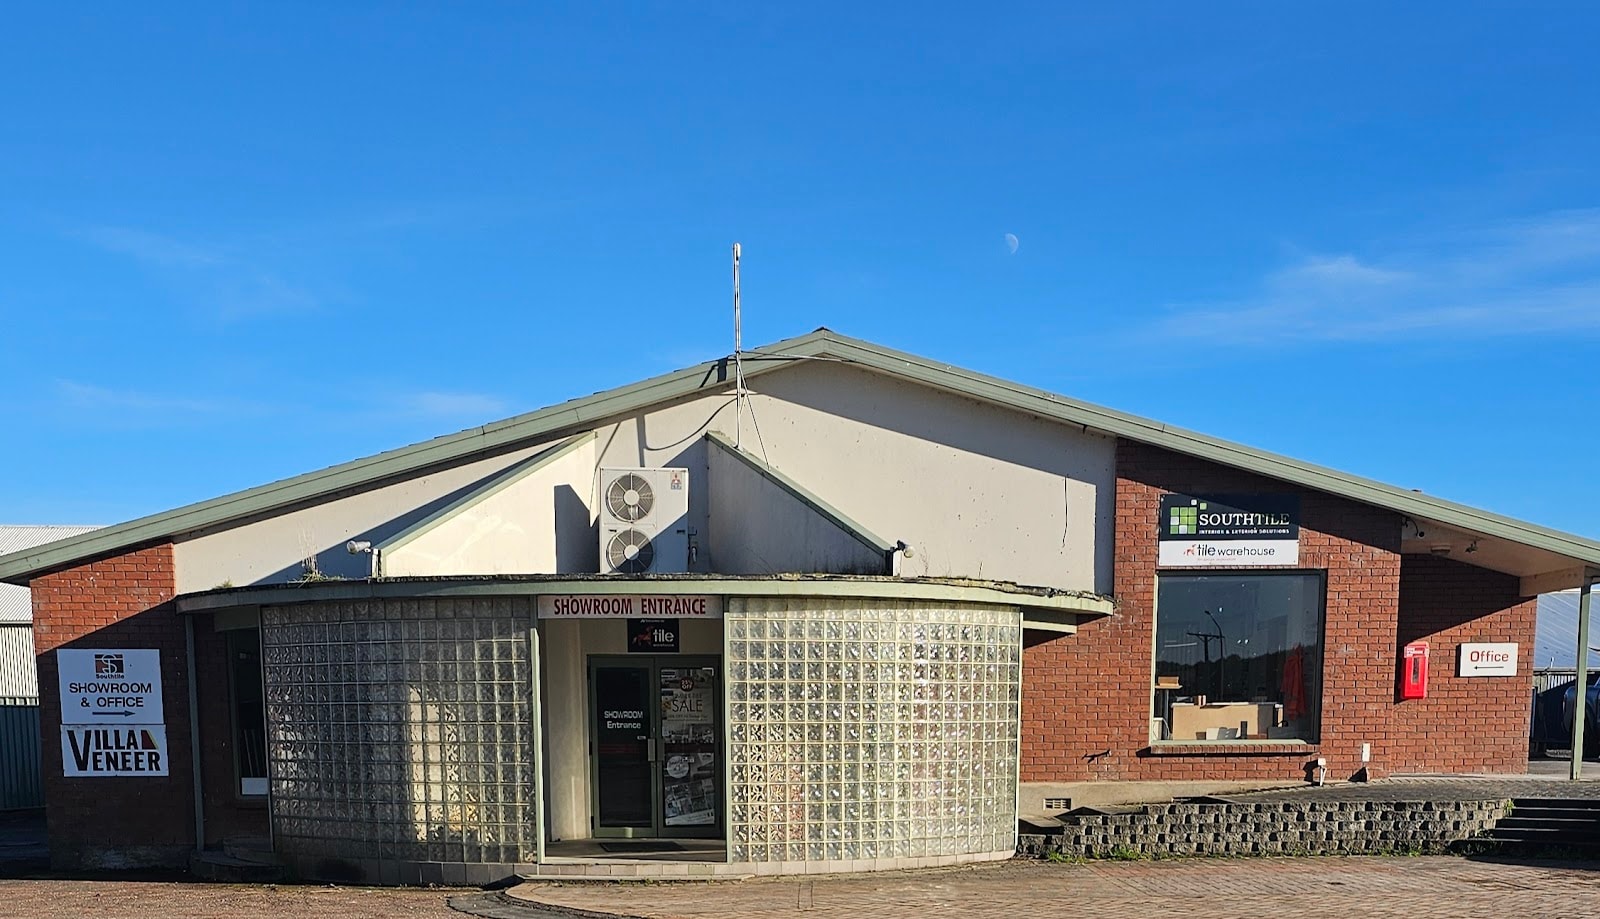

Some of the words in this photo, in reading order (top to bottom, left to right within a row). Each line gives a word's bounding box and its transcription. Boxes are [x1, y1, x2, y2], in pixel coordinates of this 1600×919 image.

[1199, 514, 1290, 526] SOUTHTILE
[1197, 544, 1216, 556] tile
[1217, 546, 1275, 556] warehouse
[554, 598, 633, 615] SHOWROOM
[641, 598, 706, 615] ENTRANCE
[652, 629, 674, 642] tile
[1470, 650, 1509, 662] Office
[69, 682, 152, 693] SHOWROOM
[80, 698, 91, 708] &
[96, 697, 144, 708] OFFICE
[672, 699, 703, 712] SALE
[604, 710, 643, 719] SHOWROOM
[606, 720, 642, 729] Entrance
